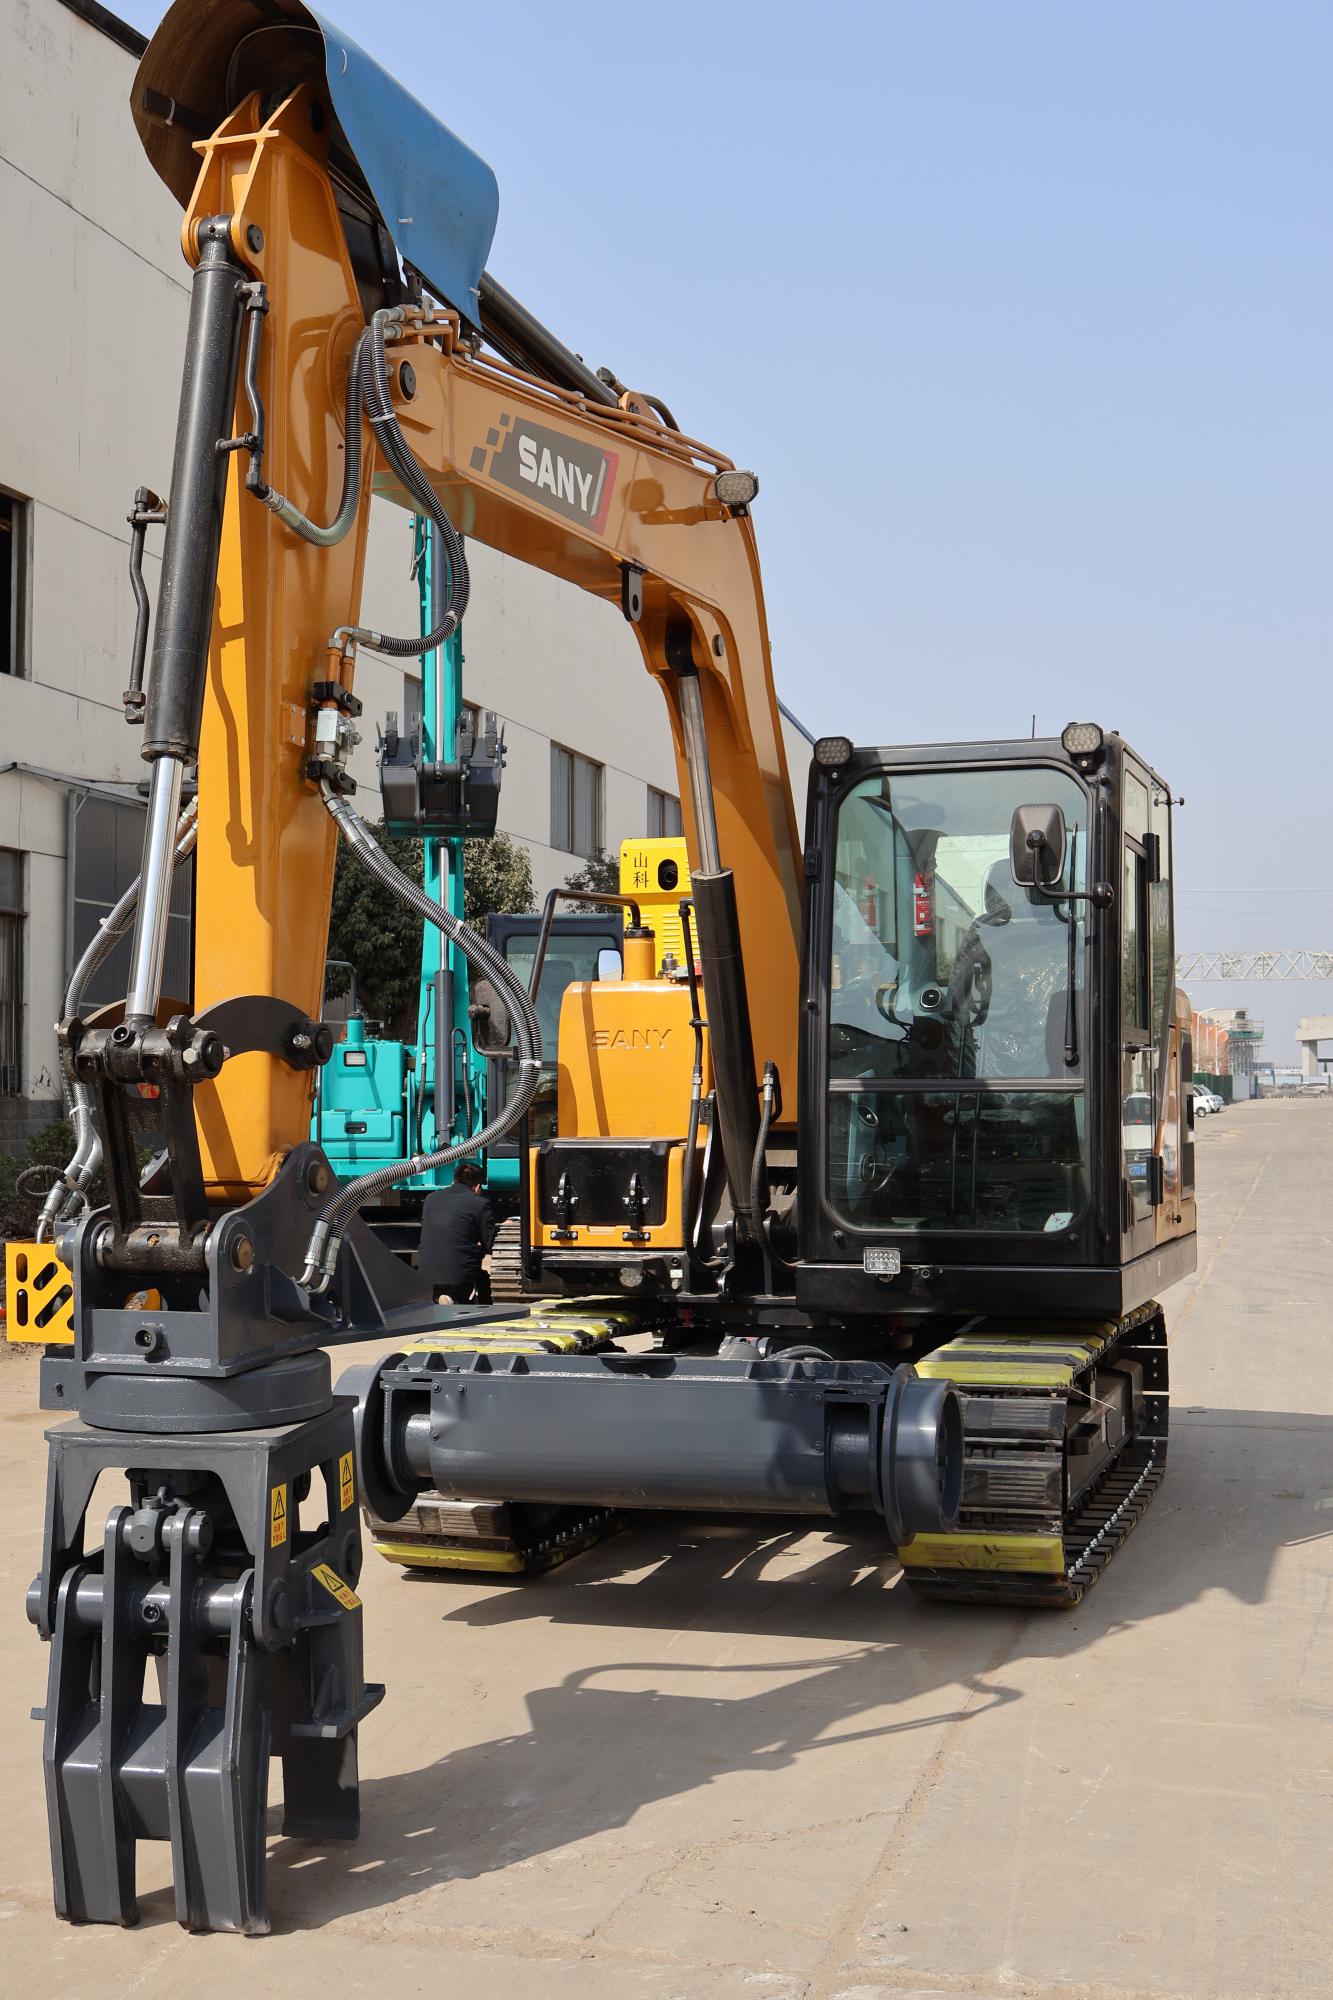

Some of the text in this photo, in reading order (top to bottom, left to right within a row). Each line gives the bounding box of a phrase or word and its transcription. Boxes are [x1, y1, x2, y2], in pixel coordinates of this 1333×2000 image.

[518, 434, 593, 512] SANY
[632, 851, 650, 889] 山科
[591, 1028, 672, 1050] SANY
